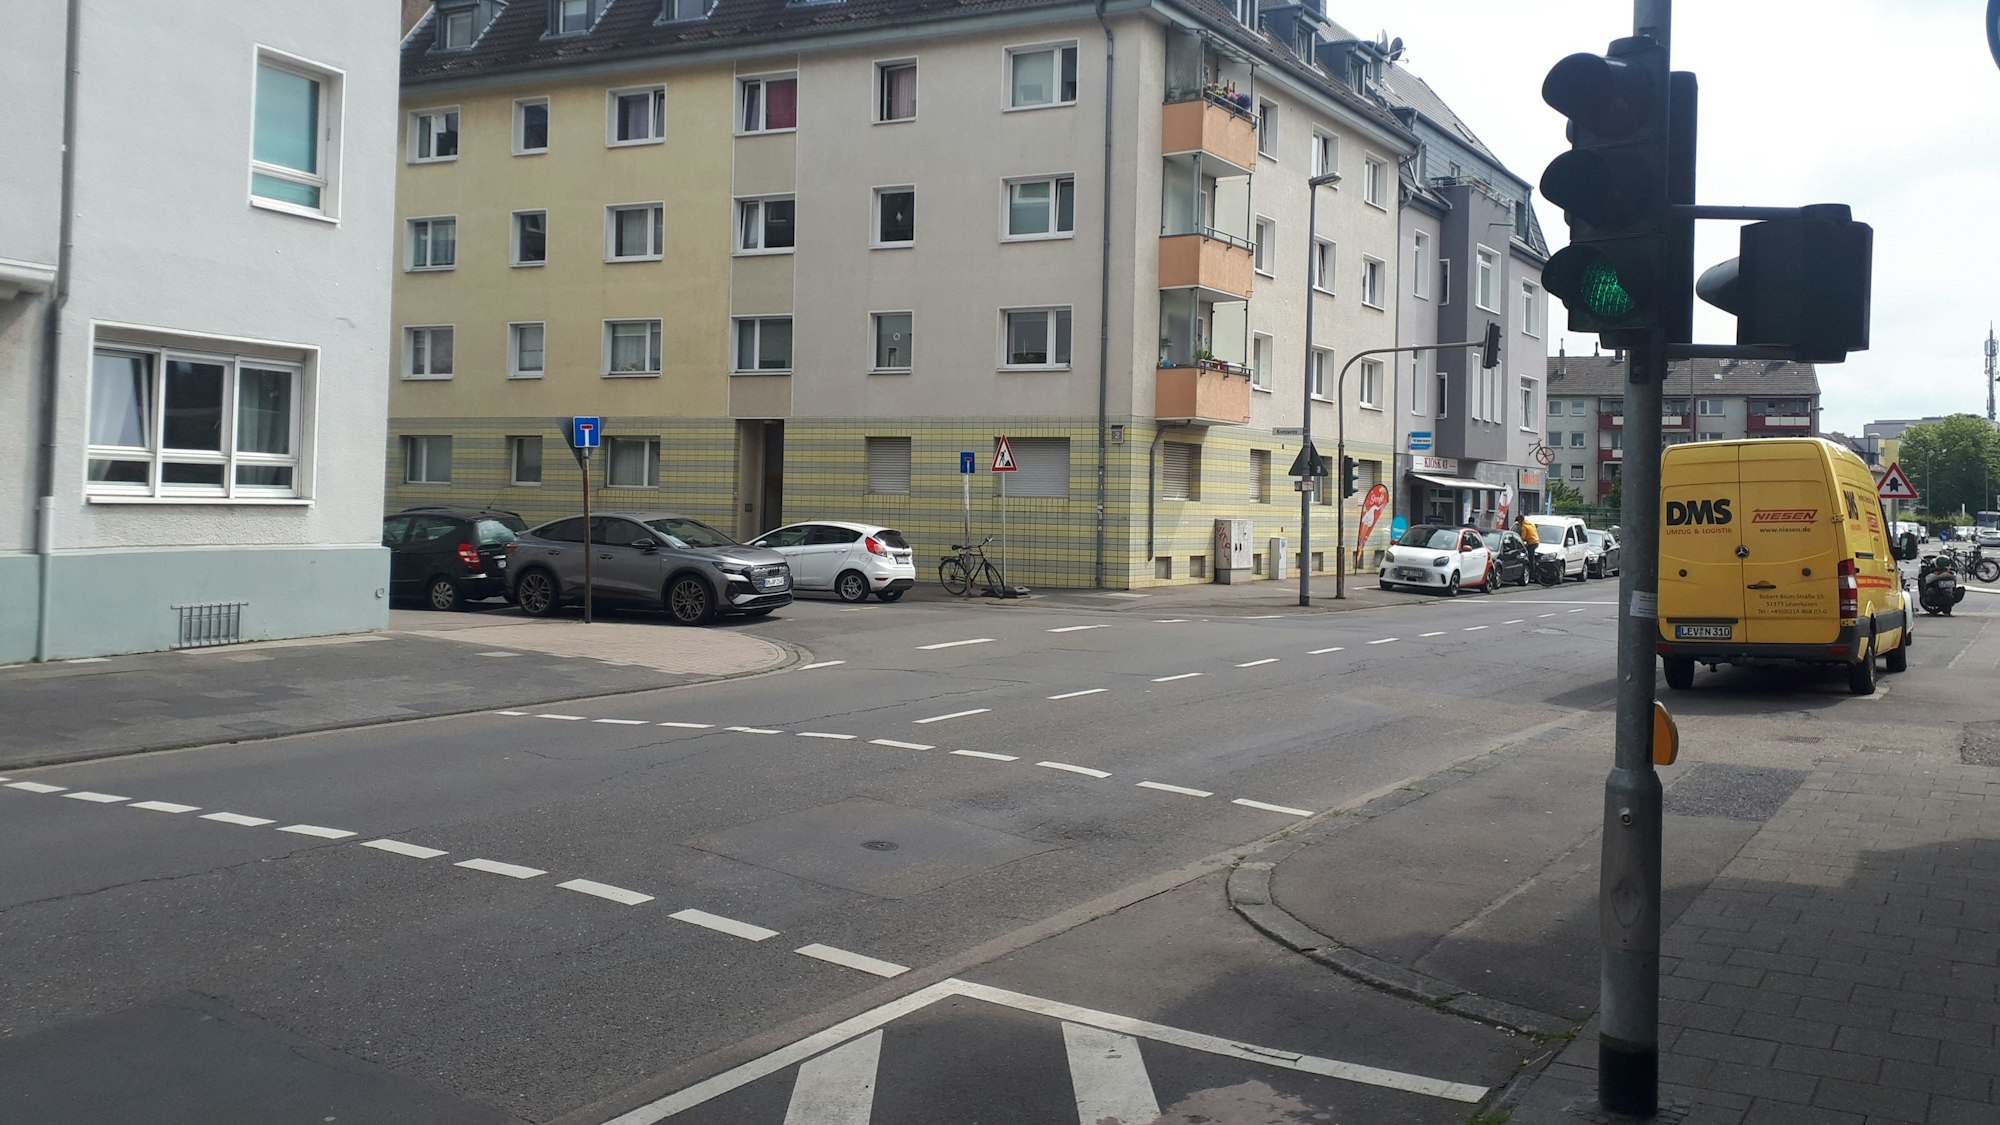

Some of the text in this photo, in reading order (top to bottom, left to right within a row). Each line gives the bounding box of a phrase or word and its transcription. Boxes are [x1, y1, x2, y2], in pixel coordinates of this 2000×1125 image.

[1424, 457, 1441, 469] KIOSK
[1666, 499, 1733, 526] DMS
[1755, 511, 1816, 520] NIESEN
[1681, 627, 1730, 637] LEV N 310
